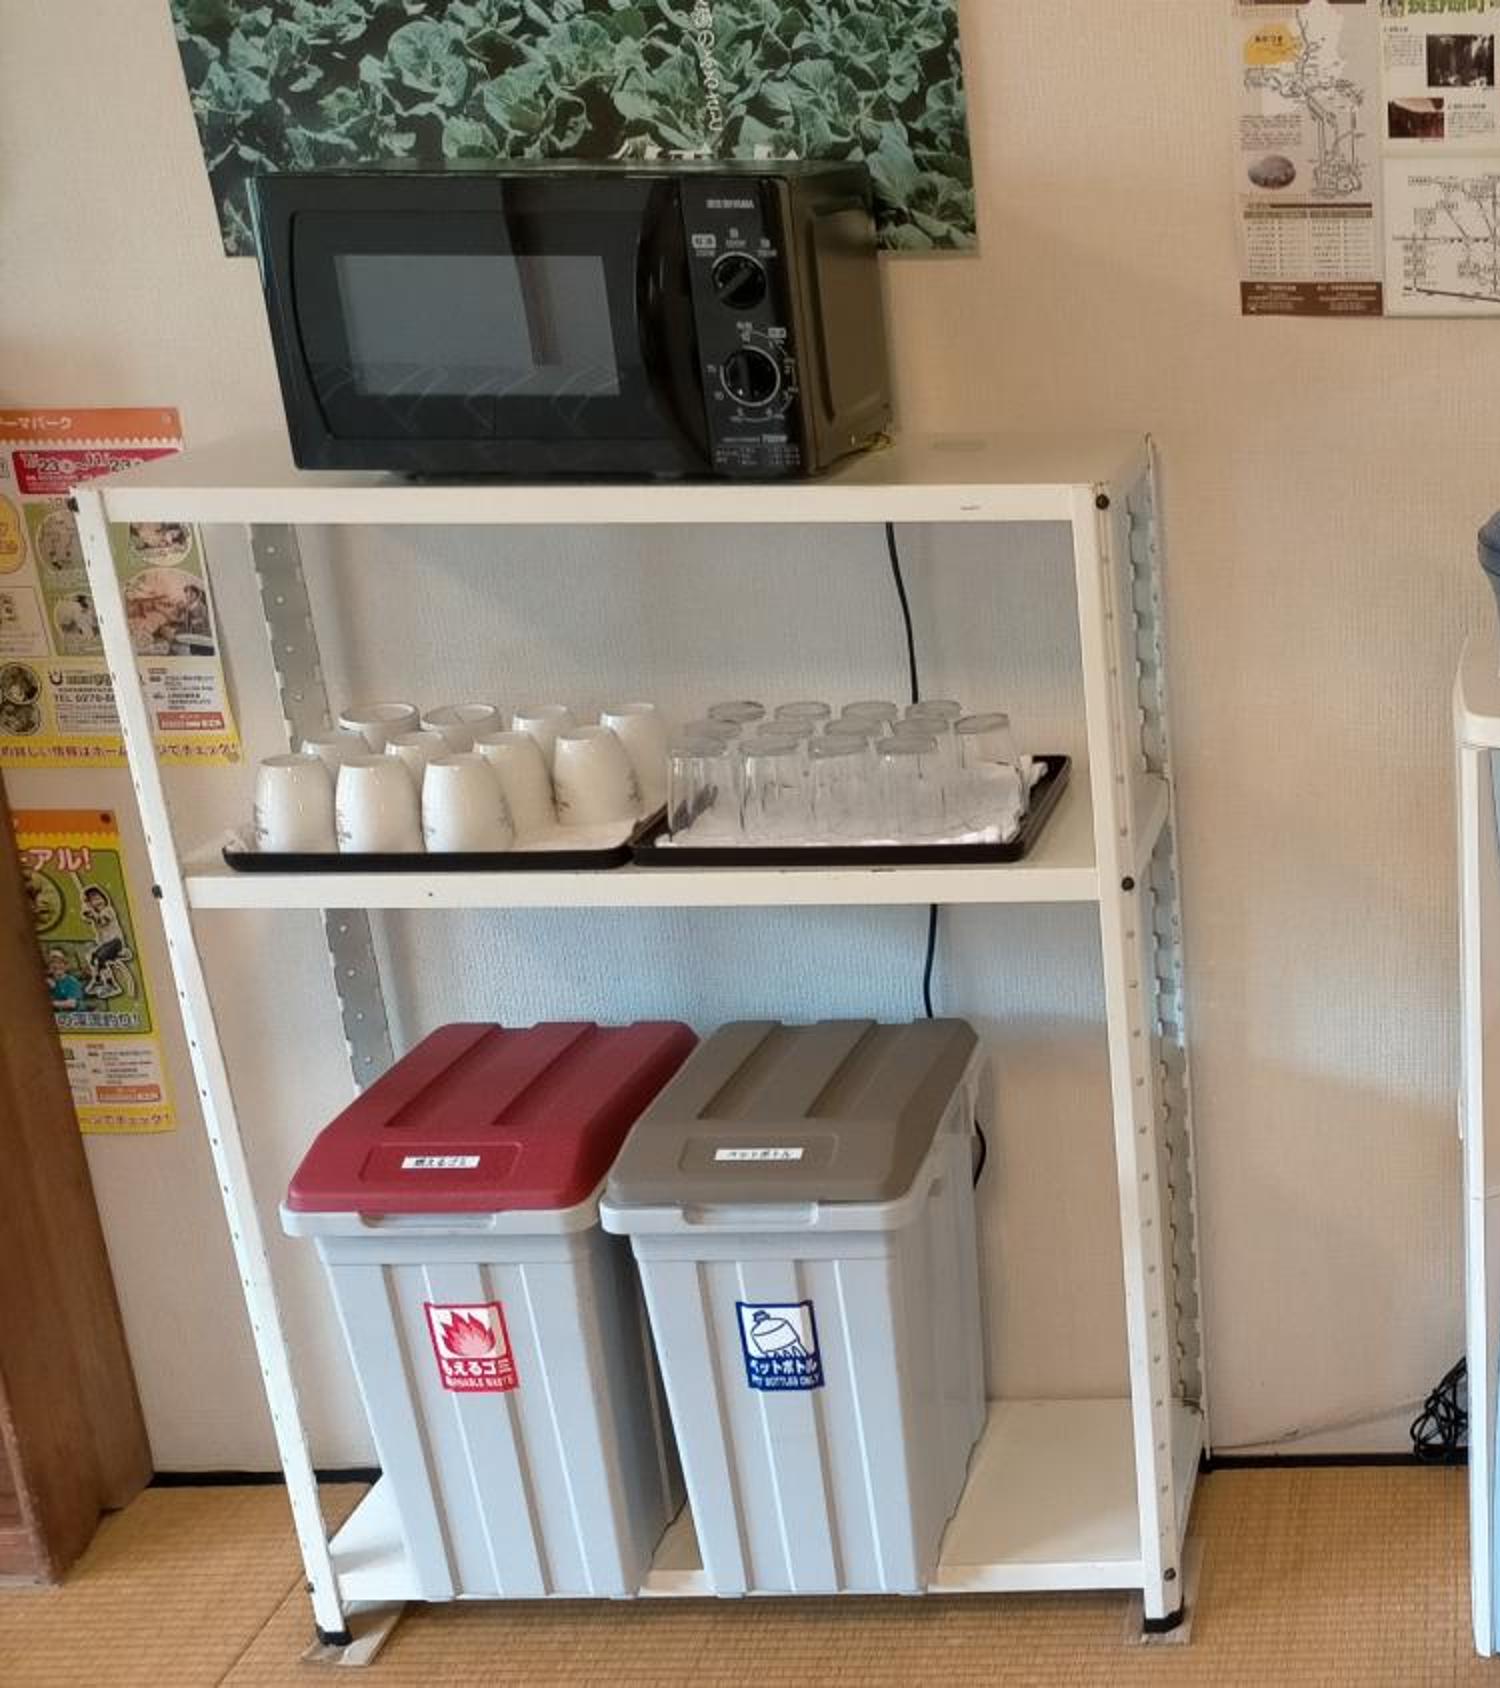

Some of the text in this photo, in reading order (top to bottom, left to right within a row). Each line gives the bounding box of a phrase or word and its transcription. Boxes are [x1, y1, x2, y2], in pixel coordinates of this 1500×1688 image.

[441, 1358, 513, 1376] もえるゴミ
[750, 1358, 817, 1375] ペットボトル
